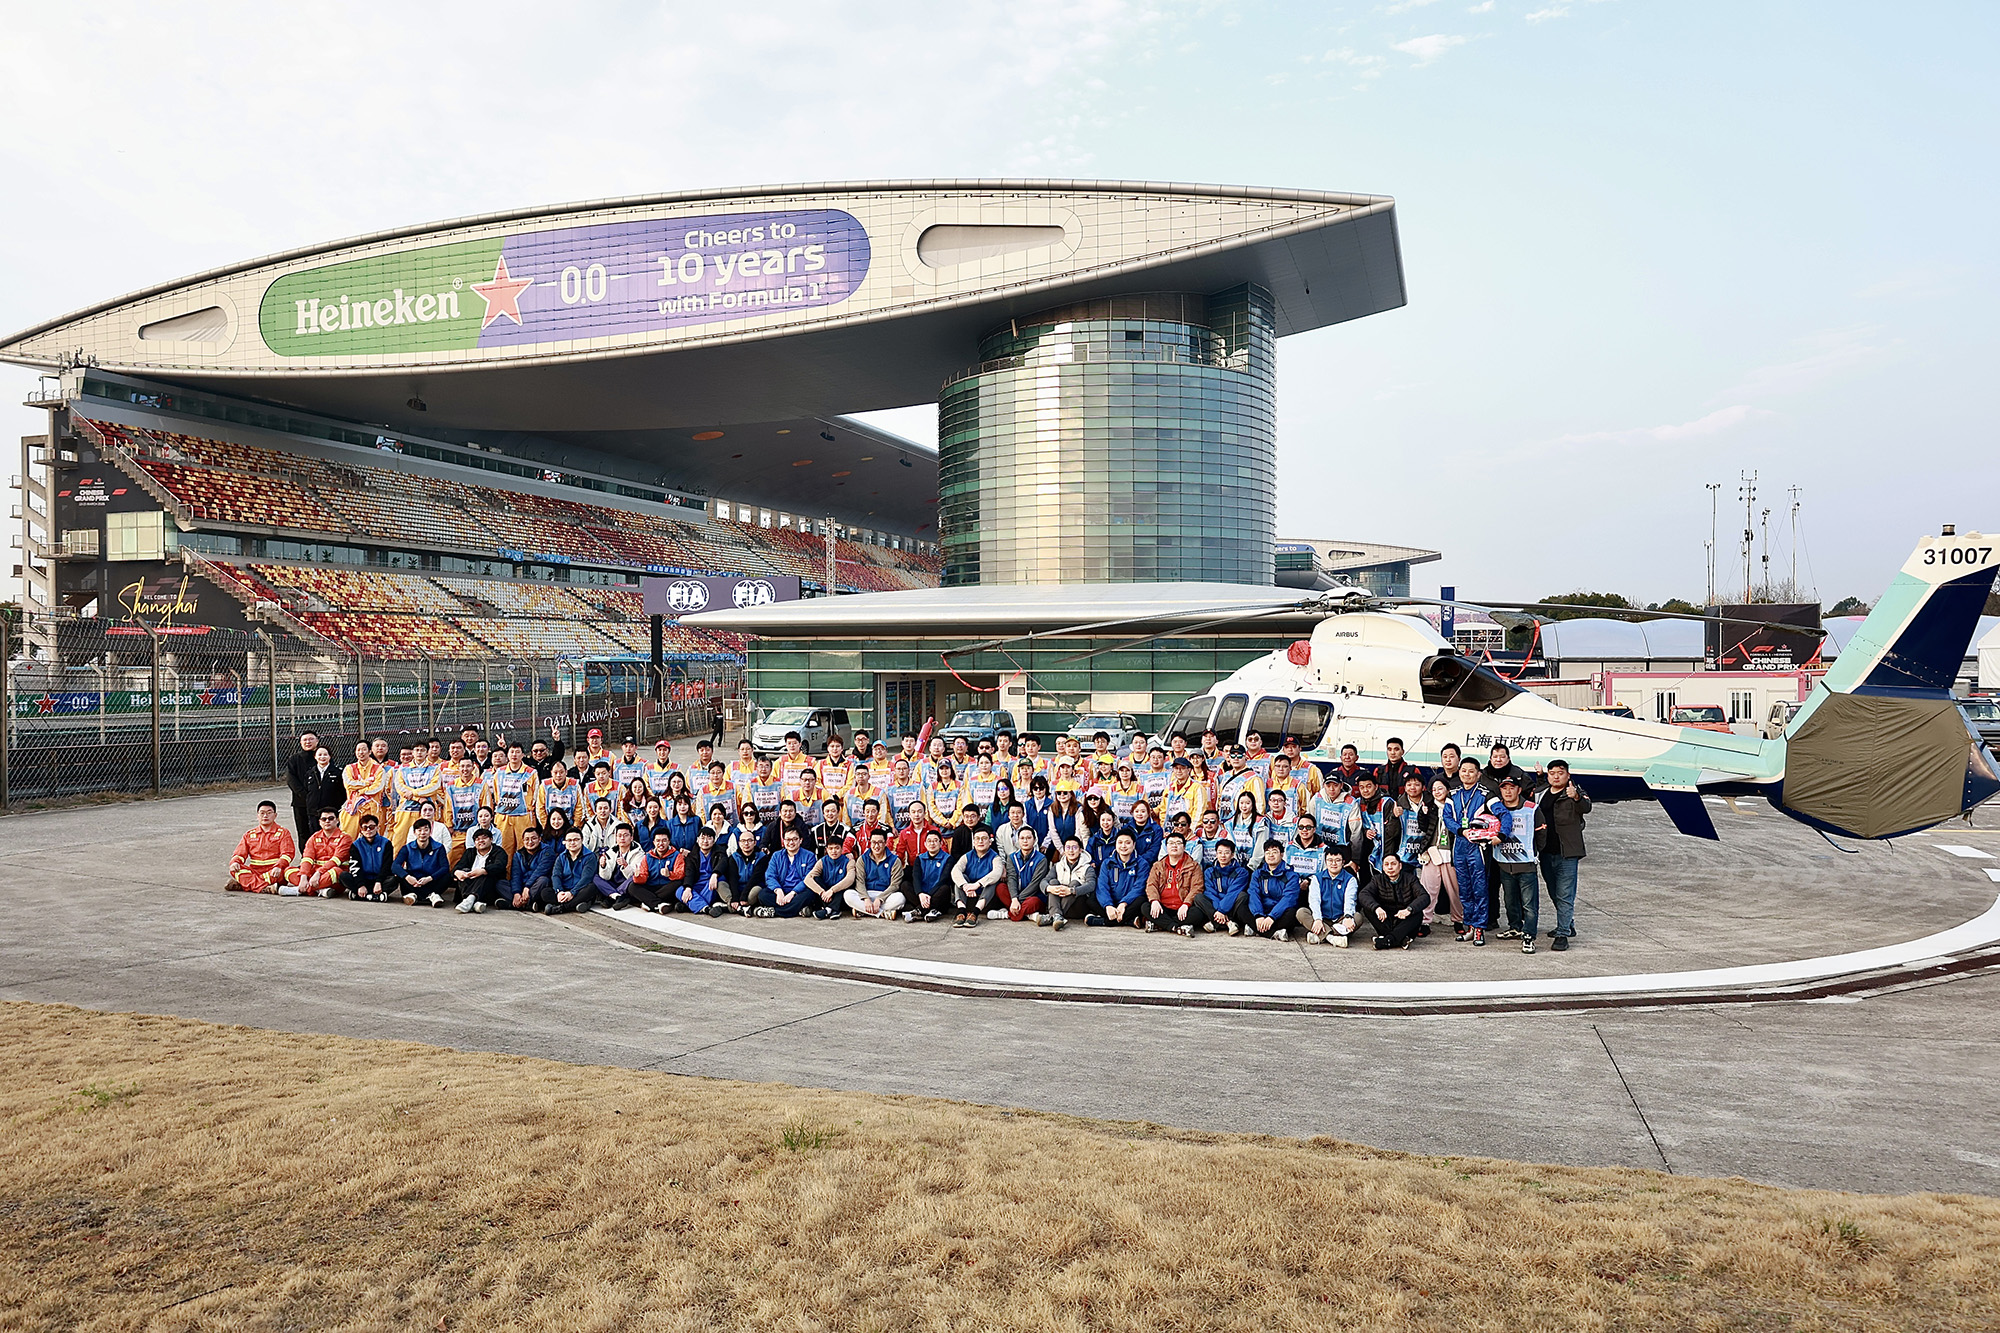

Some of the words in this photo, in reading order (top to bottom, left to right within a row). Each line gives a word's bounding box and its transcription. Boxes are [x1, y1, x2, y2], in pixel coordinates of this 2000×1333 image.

[684, 226, 765, 249] Cheers
[769, 222, 796, 240] to
[657, 252, 705, 287] 10
[713, 244, 826, 287] years
[295, 288, 461, 335] Heineken
[657, 294, 705, 315] with
[708, 284, 803, 310] Formula
[1923, 547, 1993, 565] 31007
[118, 574, 198, 645] Shanghai
[130, 693, 193, 706] Heieken
